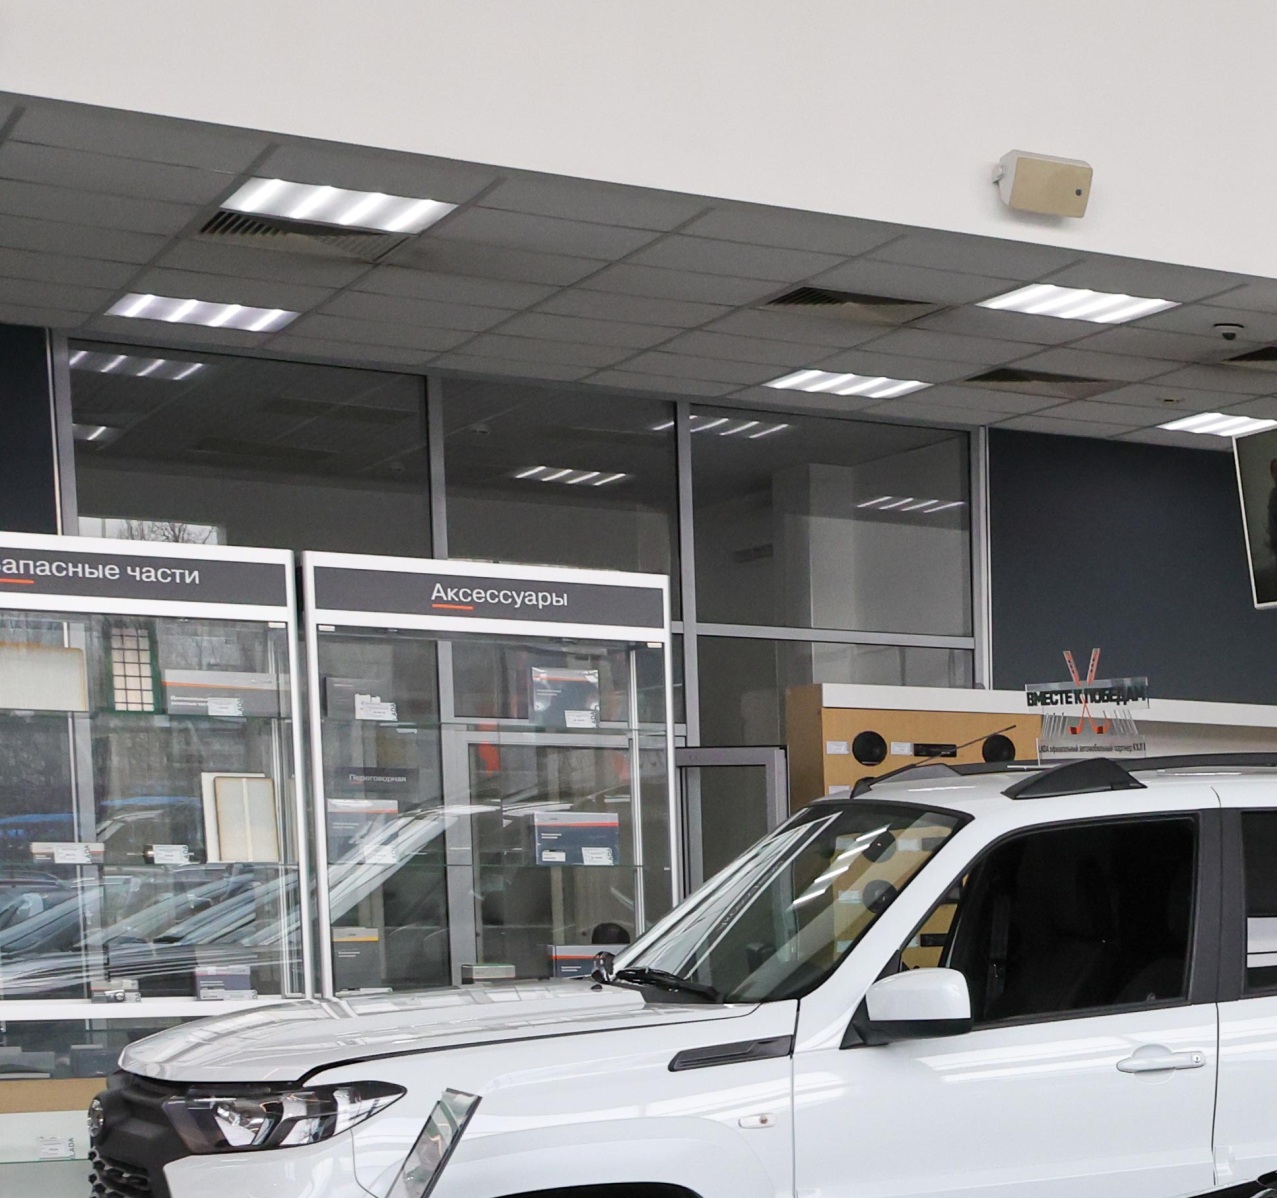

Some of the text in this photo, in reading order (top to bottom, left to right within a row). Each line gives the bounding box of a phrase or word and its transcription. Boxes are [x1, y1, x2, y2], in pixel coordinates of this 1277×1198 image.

[0, 558, 200, 584] апасные части
[431, 583, 568, 609] Аксессуары
[1026, 688, 1073, 707] ВМЕСТЕ
[349, 774, 406, 782] Переговорная
